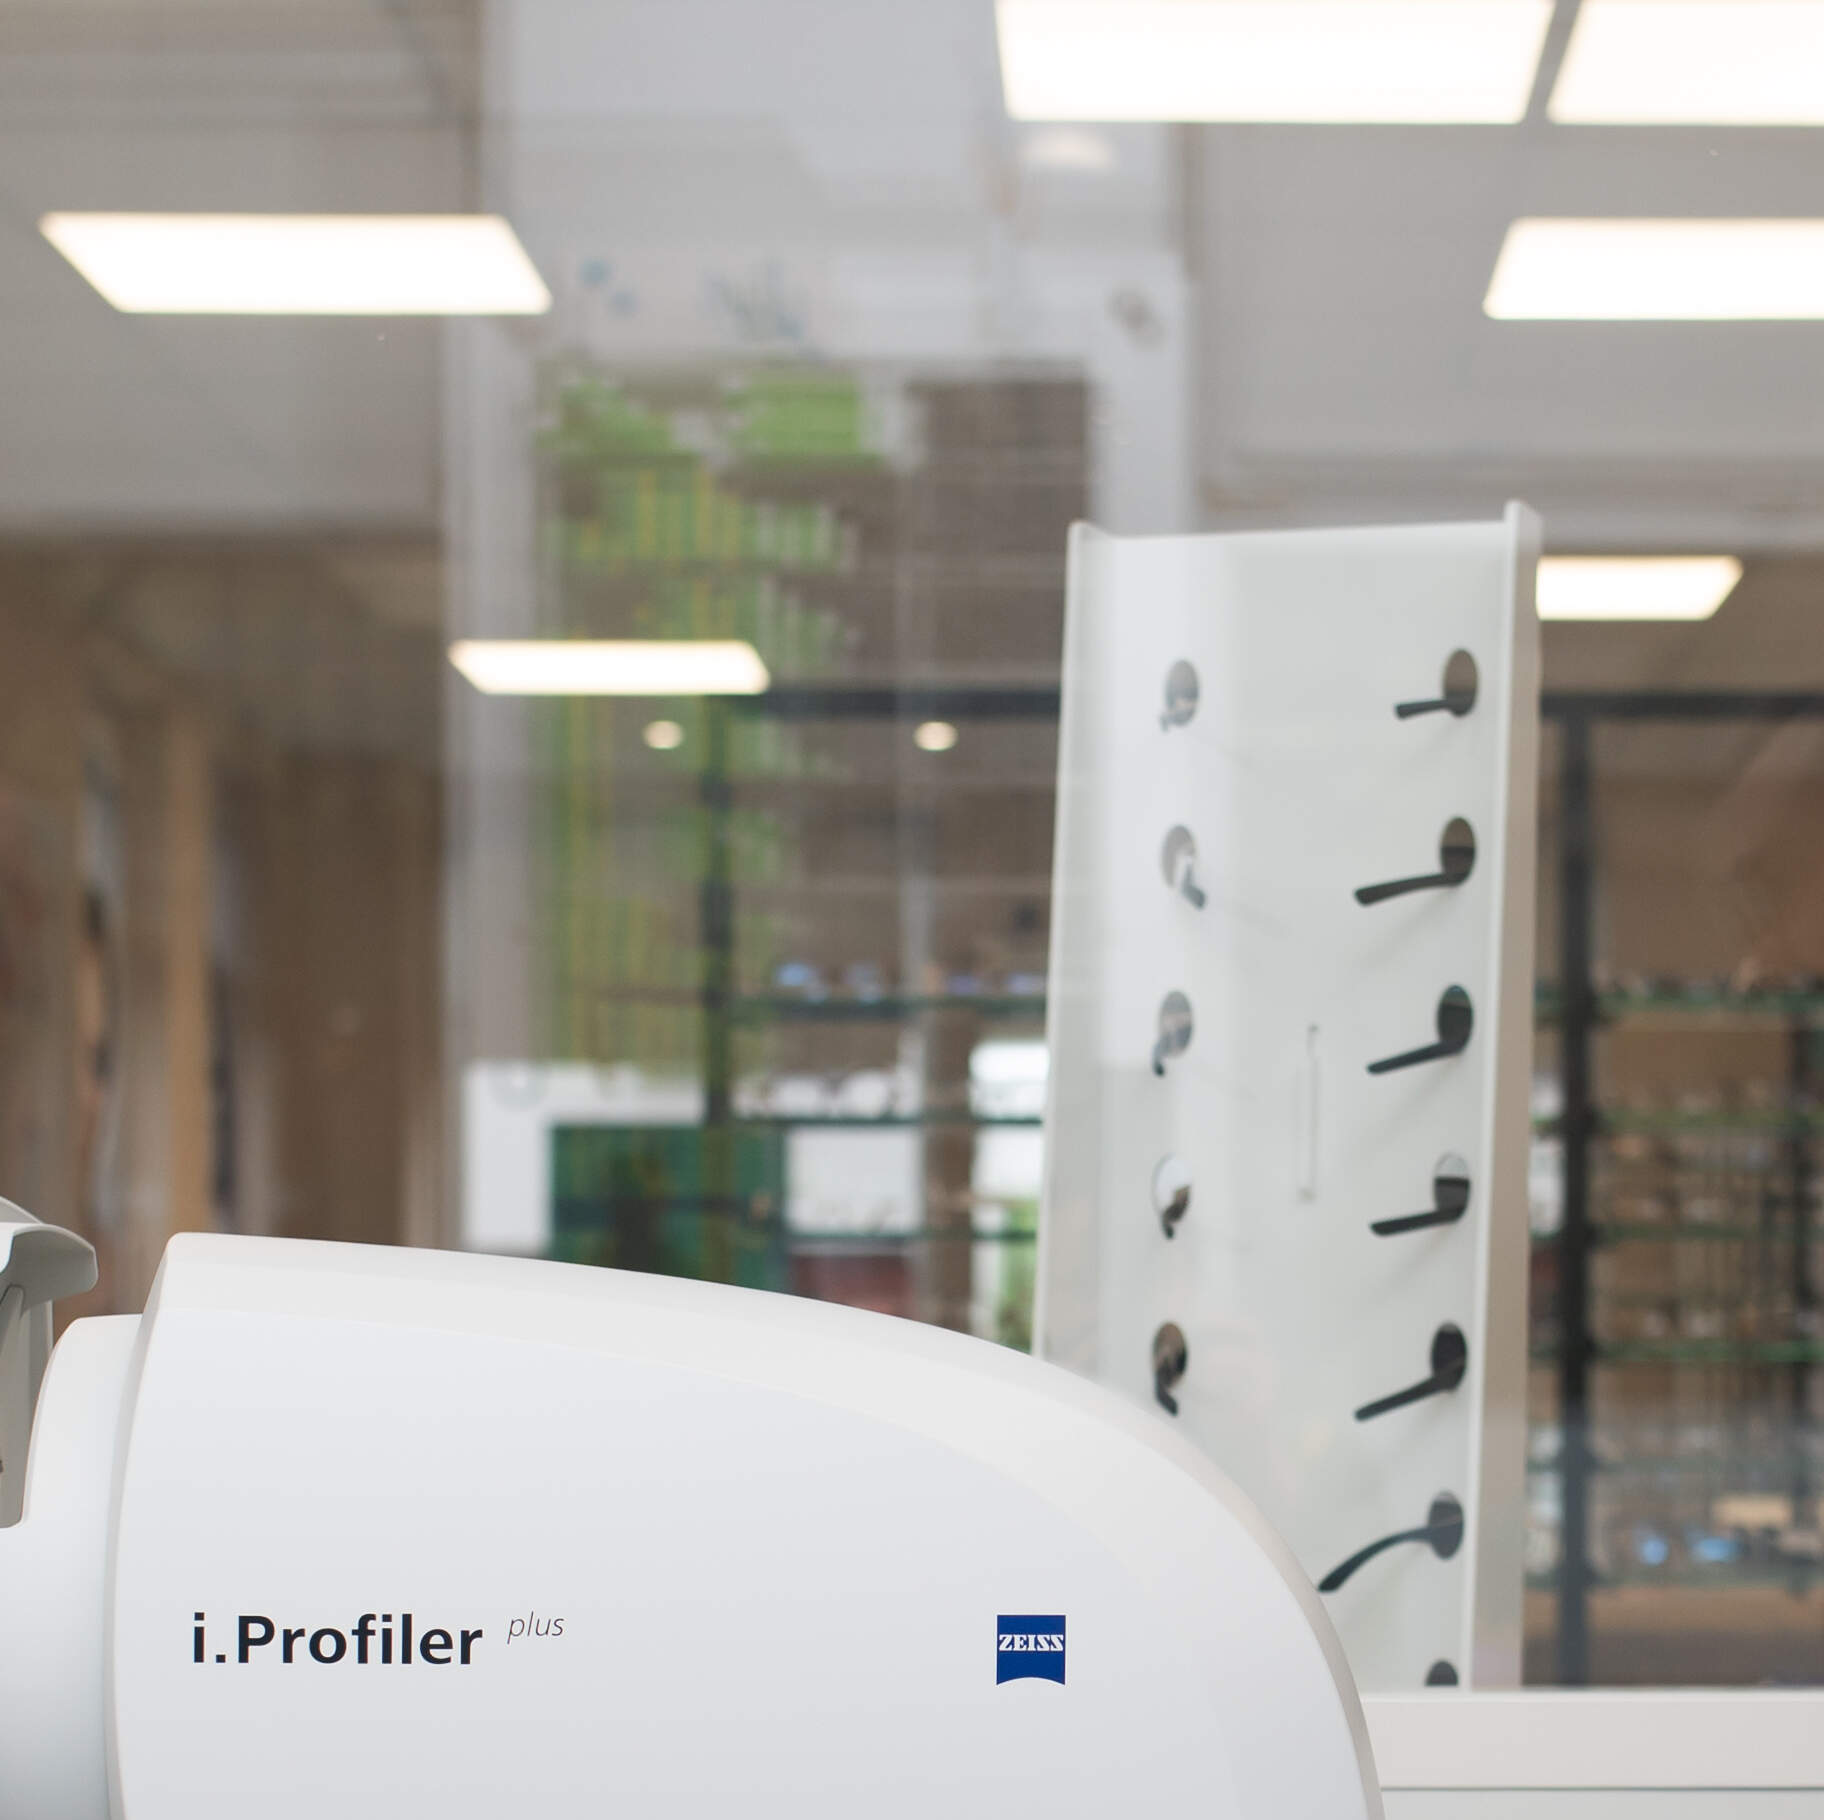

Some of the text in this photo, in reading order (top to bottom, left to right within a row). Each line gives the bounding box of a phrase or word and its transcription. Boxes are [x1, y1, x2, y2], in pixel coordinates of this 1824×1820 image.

[193, 1611, 565, 1665] i.Profiler plus
[999, 1634, 1064, 1651] ZEISS
